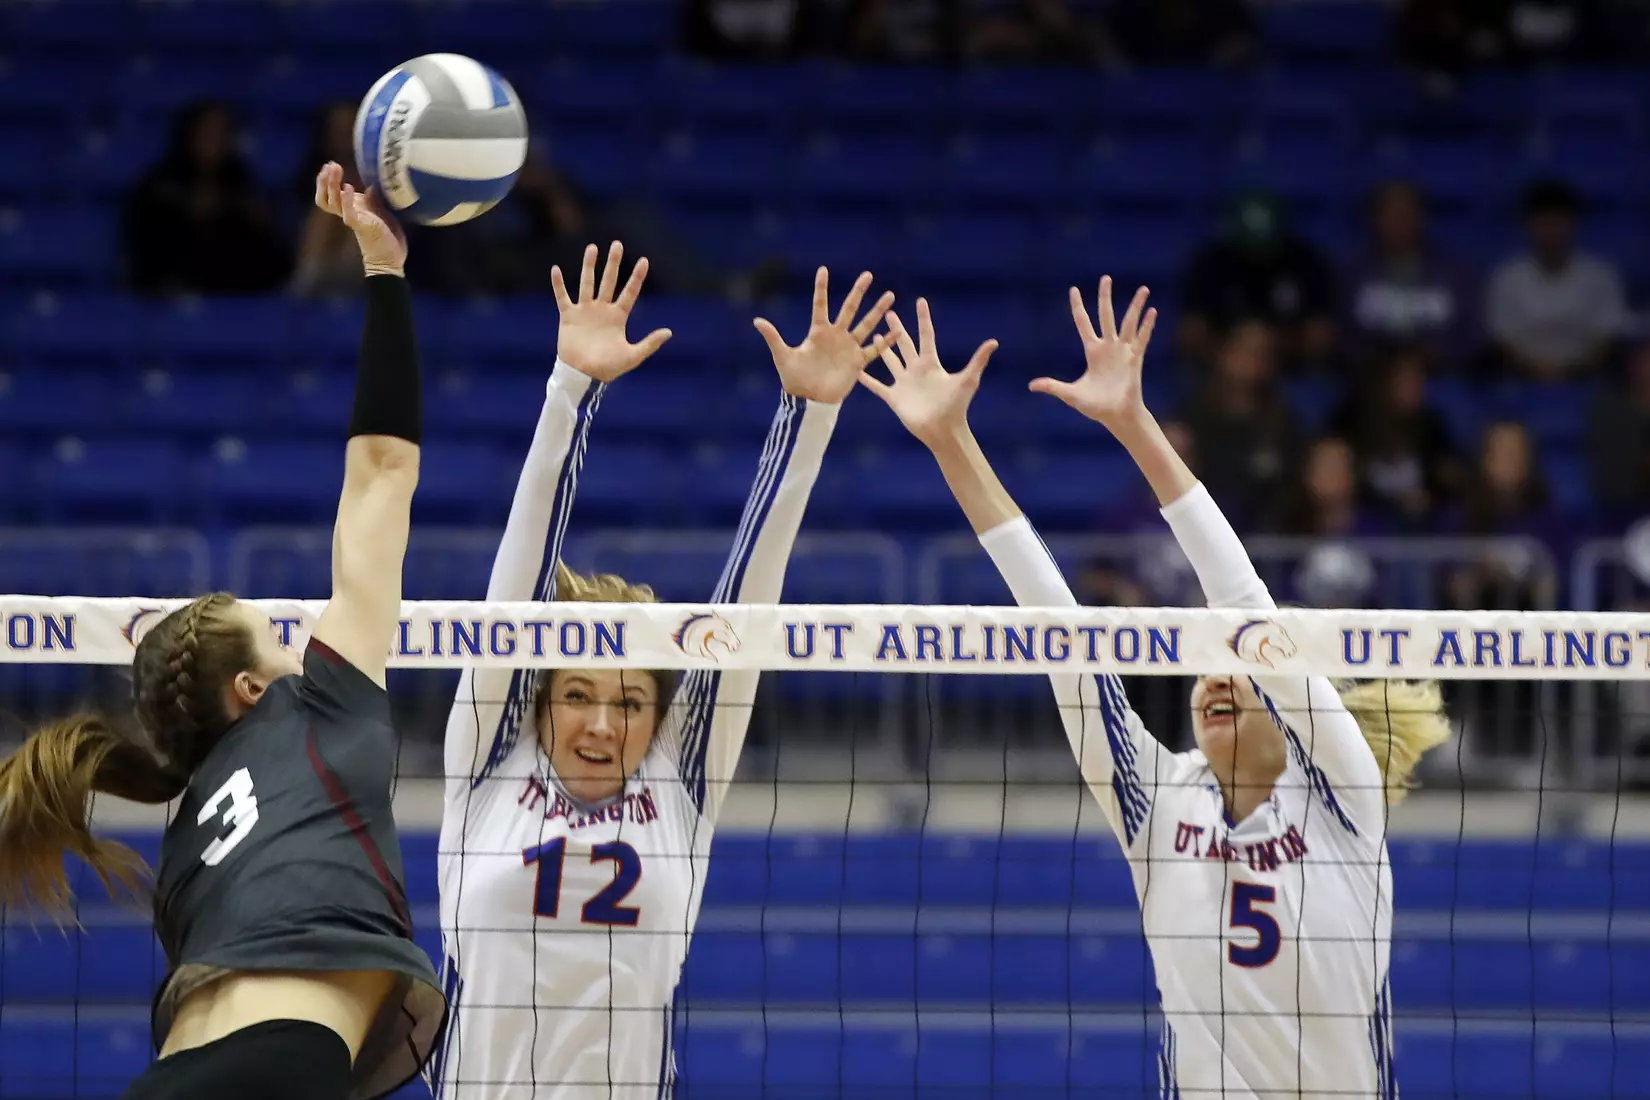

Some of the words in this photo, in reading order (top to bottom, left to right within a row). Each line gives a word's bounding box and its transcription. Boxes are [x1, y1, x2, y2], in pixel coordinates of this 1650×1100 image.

[0, 612, 77, 652] ON
[268, 615, 304, 651] T
[387, 619, 628, 660] LINGTON
[783, 623, 854, 661] UT
[873, 624, 1184, 665] ARLINGTON
[1340, 628, 1411, 668] UT
[196, 766, 260, 867] 3
[522, 836, 642, 927] 12
[1228, 881, 1283, 969] 5
